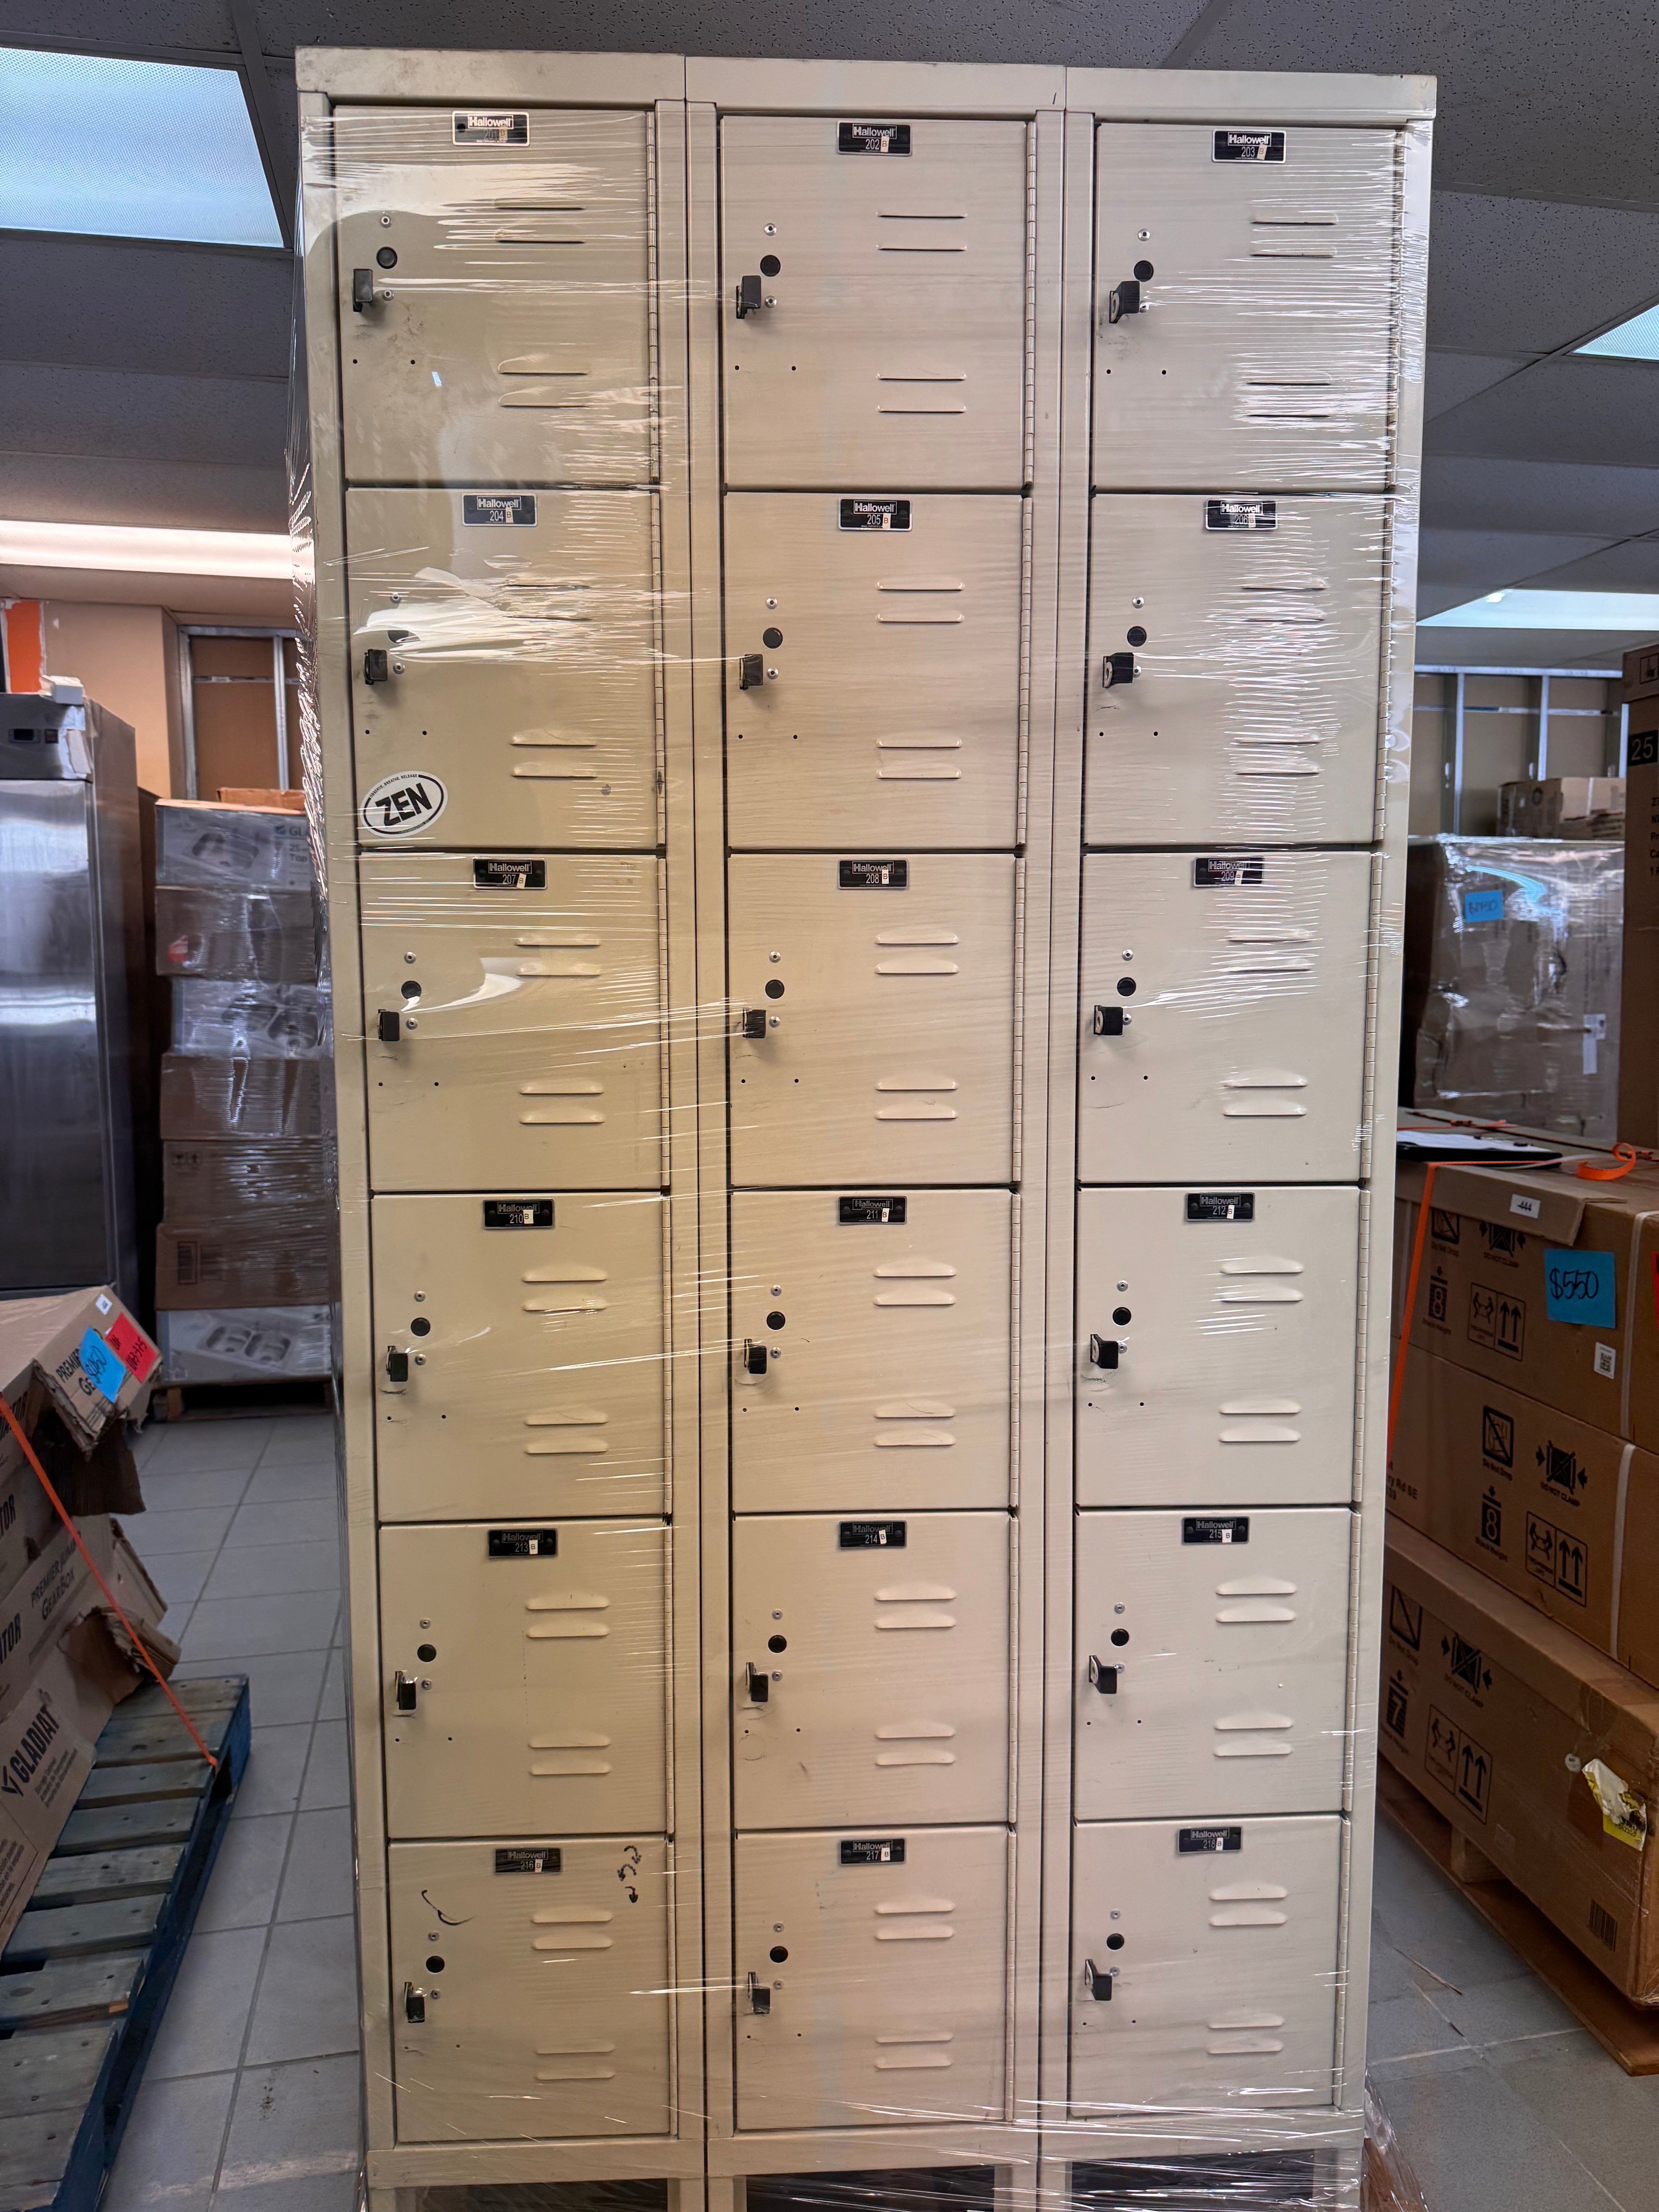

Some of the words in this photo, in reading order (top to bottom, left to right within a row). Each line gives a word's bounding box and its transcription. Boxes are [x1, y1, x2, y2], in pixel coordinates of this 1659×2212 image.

[469, 116, 512, 127] Hallowell
[854, 125, 895, 137] Hallowell
[866, 139, 879, 149] 202
[1229, 134, 1269, 144] Hallowell
[1242, 147, 1255, 157] 203
[479, 498, 519, 508] Hallowell
[855, 502, 895, 512] Hallowell
[1222, 504, 1261, 513] Hallowell
[490, 511, 503, 521] 204
[867, 515, 881, 525] 205
[1235, 515, 1247, 525] 206
[1631, 737, 1653, 761] 25
[375, 783, 432, 826] ZEN
[489, 863, 530, 872] Hallowell
[1209, 861, 1248, 871] Hallowell
[503, 874, 515, 884] 207
[866, 874, 879, 883] 208
[1221, 872, 1234, 881] 209
[1201, 1197, 1239, 1205] Hallowell
[867, 1210, 878, 1219] 211
[1213, 1206, 1226, 1215] 212
[510, 1214, 523, 1223] 210
[1549, 1267, 1599, 1300] $550
[866, 1535, 878, 1543] 214
[1209, 1530, 1221, 1538] 215
[515, 1543, 528, 1552] 213
[1203, 1840, 1215, 1848] 218
[866, 1851, 878, 1860] 217
[521, 1861, 533, 1869] 216
